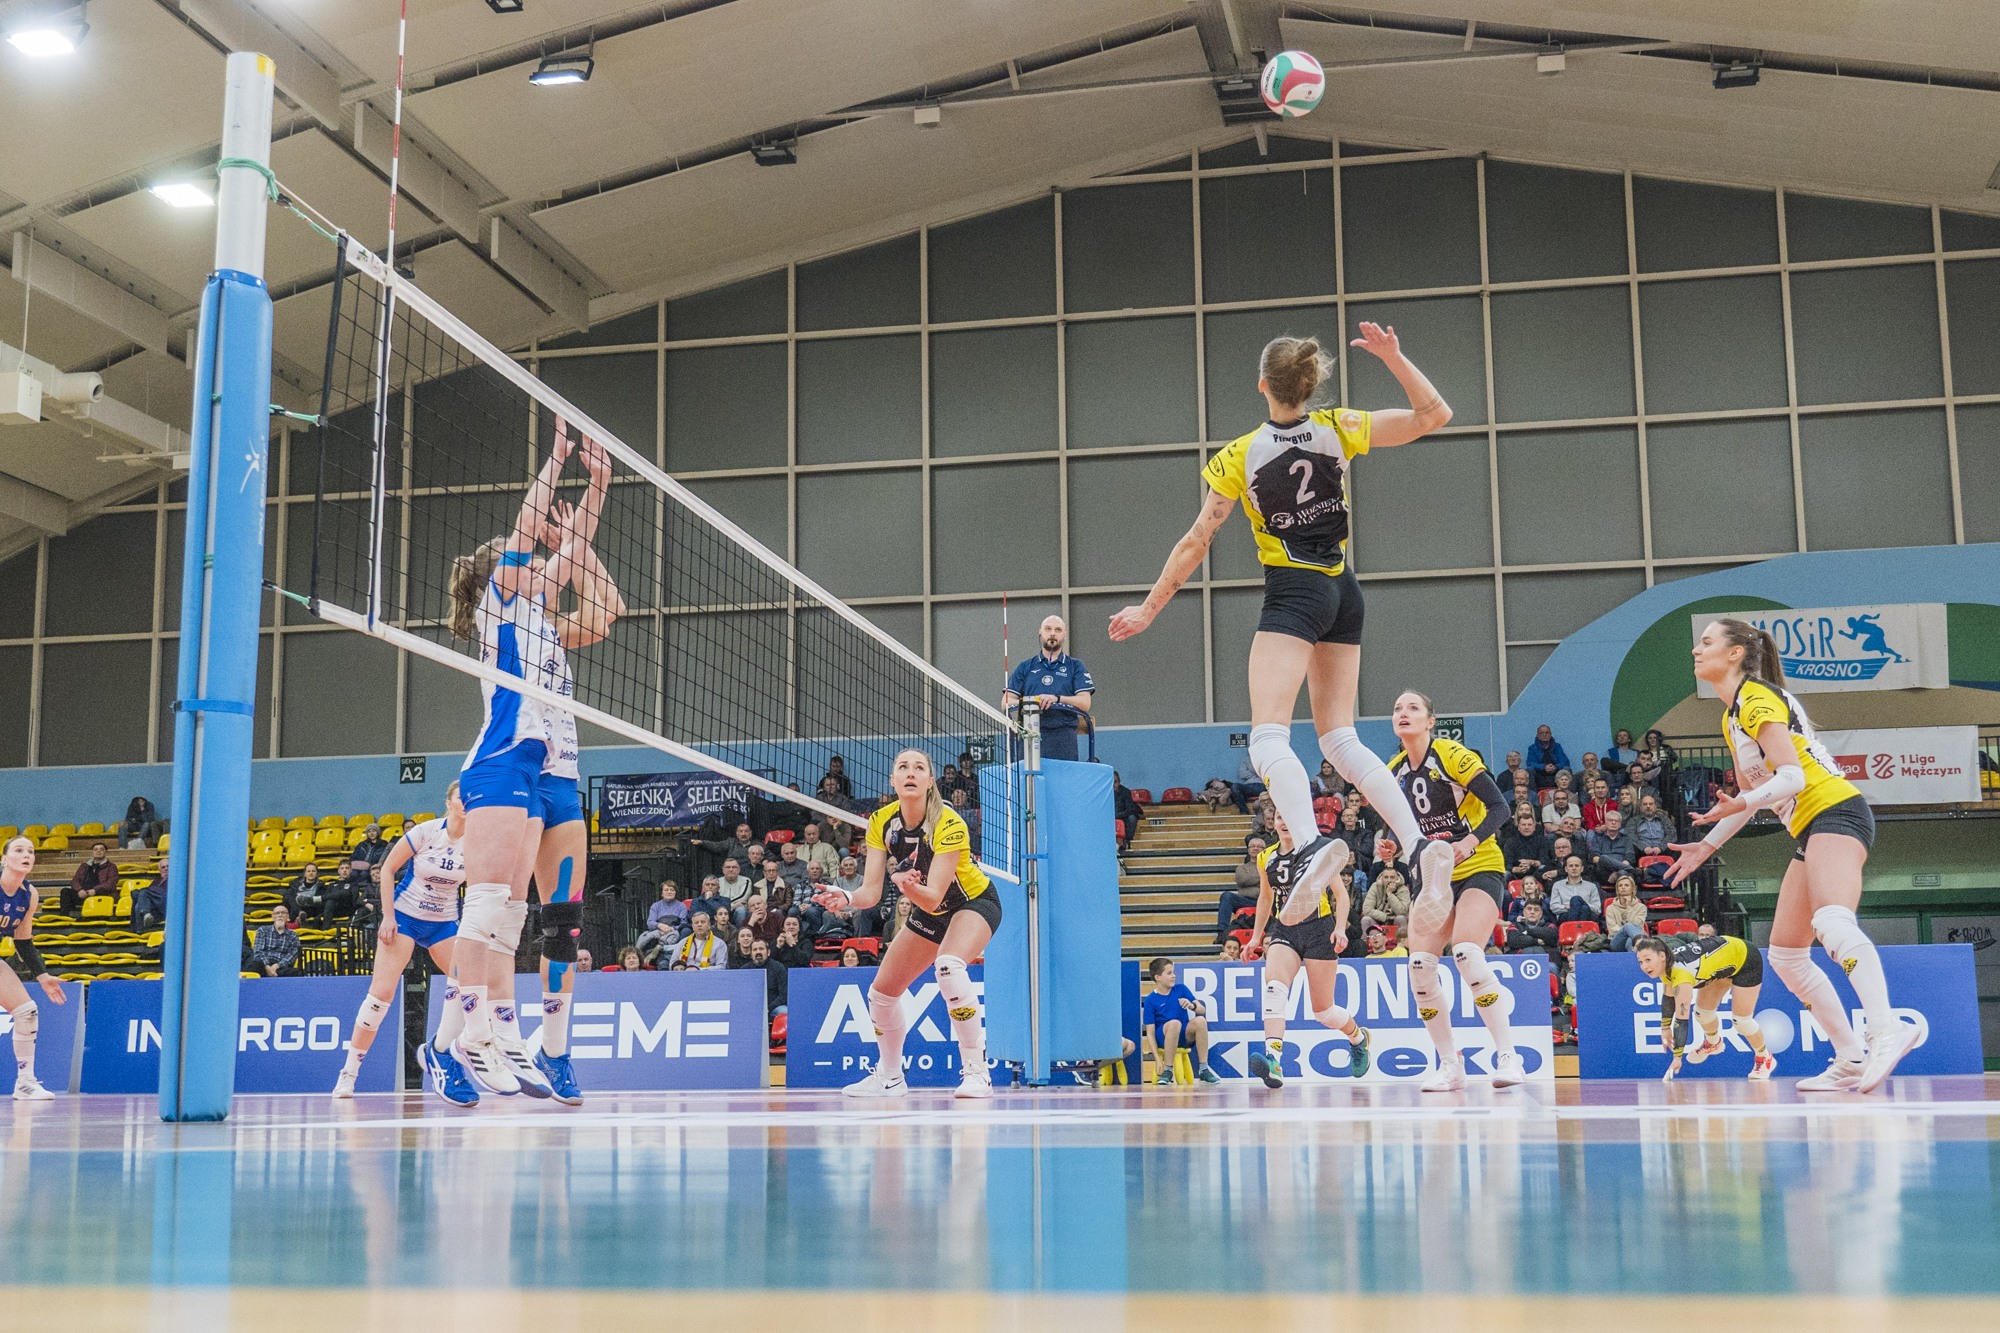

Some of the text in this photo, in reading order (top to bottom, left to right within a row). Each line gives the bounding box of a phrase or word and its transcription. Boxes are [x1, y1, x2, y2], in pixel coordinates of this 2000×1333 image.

[1289, 459, 1316, 504] 2
[1796, 662, 1862, 678] KROSNO
[1436, 718, 1463, 726] SEKTOR
[1438, 728, 1463, 742] B2
[401, 757, 425, 765] SEKTOR
[1900, 754, 1936, 766] 1 Liga
[401, 766, 423, 781] A2
[1901, 766, 1962, 779] Mężczyzn
[608, 788, 675, 810] SELENKA
[1412, 776, 1432, 814] 8
[611, 806, 673, 818] WIENIEC ZDRÓJ
[905, 837, 919, 868] 7
[440, 858, 454, 870] 18
[1276, 860, 1291, 883] 5
[842, 1056, 933, 1070] PRWO
